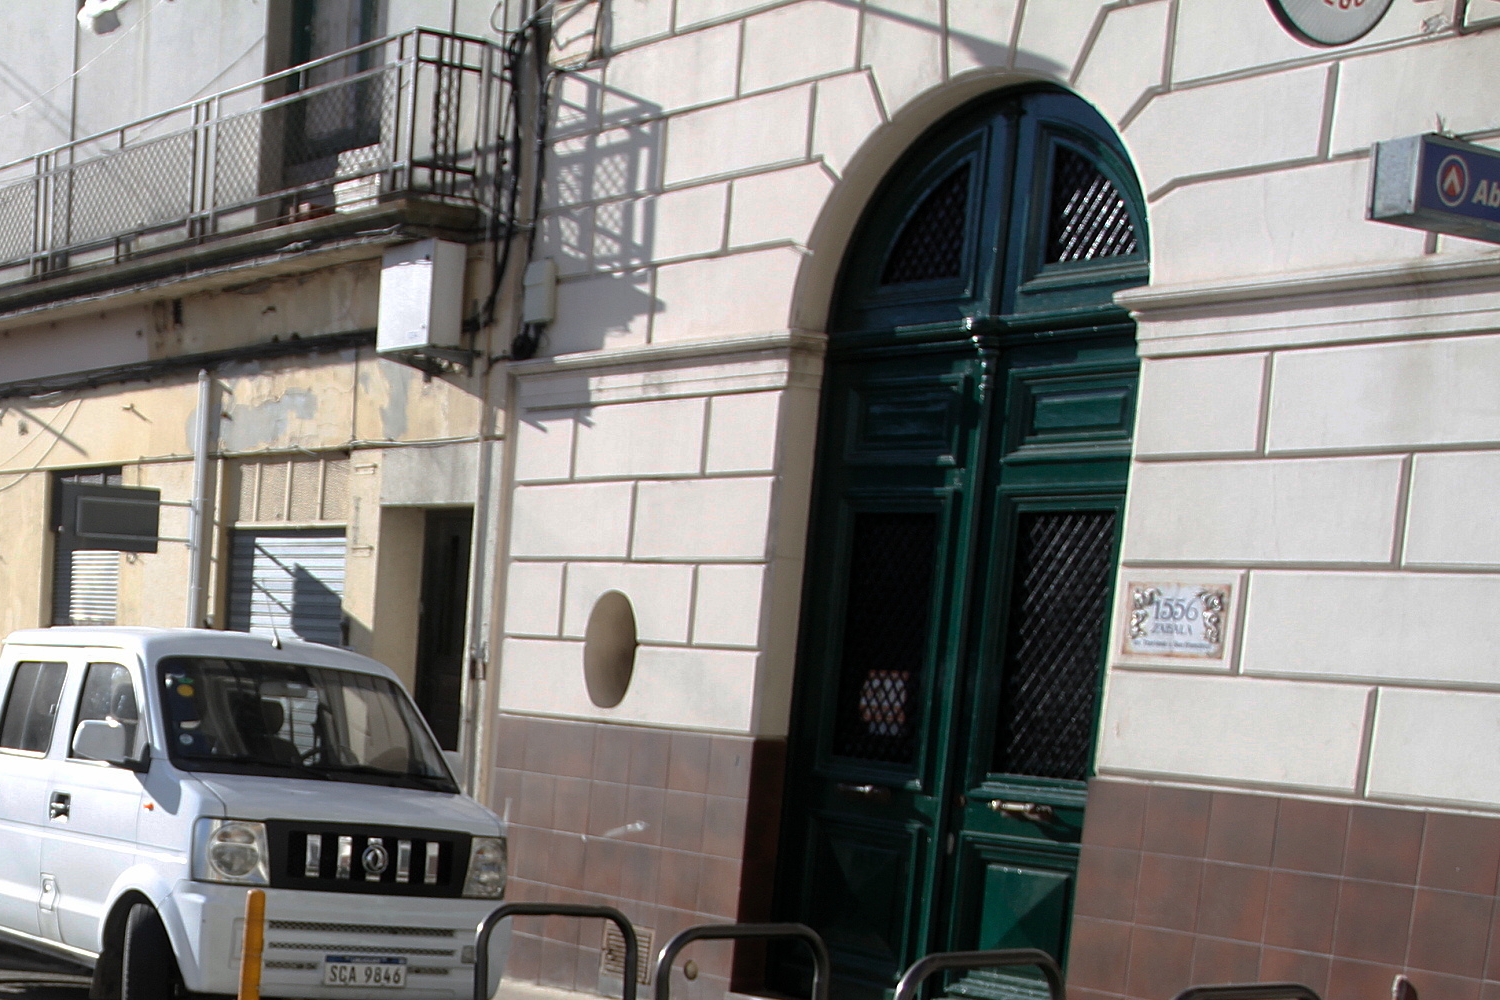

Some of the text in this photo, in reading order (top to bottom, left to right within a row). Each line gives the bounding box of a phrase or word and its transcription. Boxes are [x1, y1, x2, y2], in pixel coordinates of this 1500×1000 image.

[1153, 598, 1199, 621] 1556
[329, 964, 402, 984] SCA 9846
